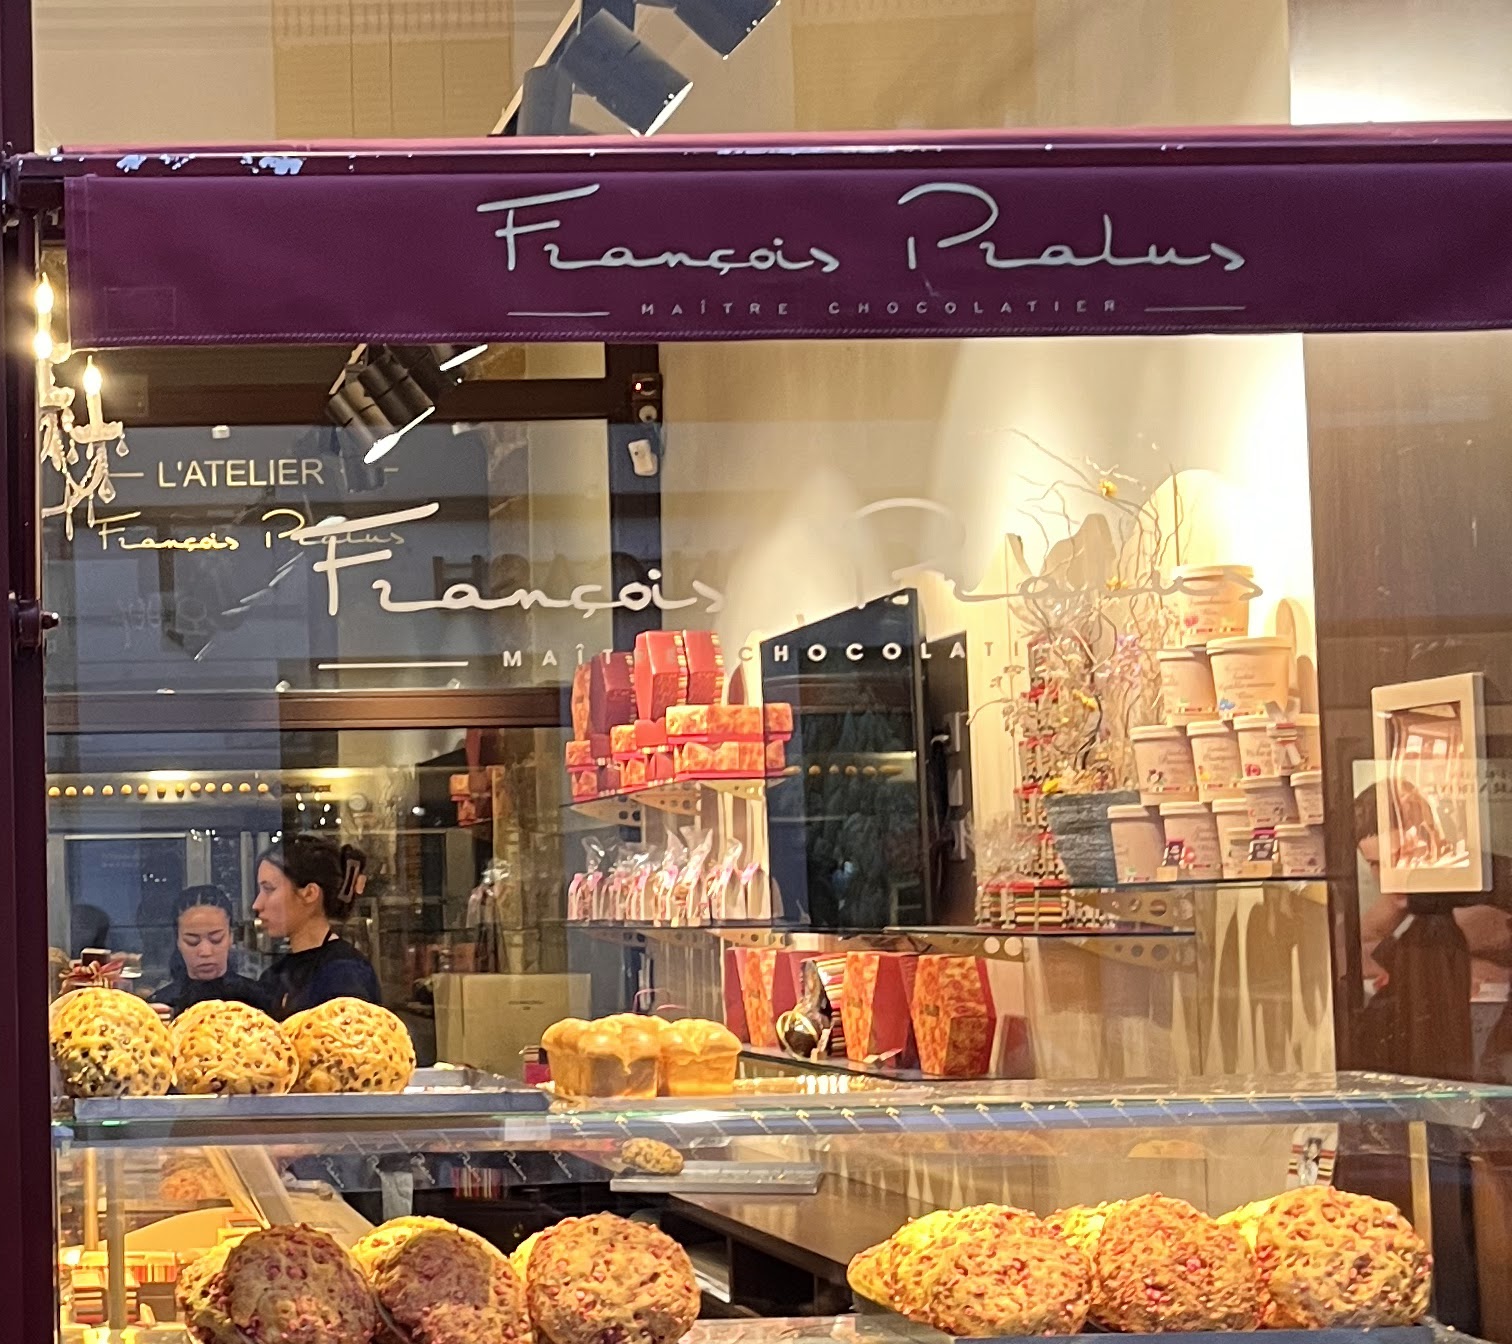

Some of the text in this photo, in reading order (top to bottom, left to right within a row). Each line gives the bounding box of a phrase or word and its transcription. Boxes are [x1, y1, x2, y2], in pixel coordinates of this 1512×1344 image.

[477, 182, 1246, 276] François Pralus
[640, 299, 1116, 316] MAÎTRE CHOCOLATIER
[157, 459, 325, 488] L'ATELIER
[92, 511, 240, 552] François
[291, 502, 727, 618] François
